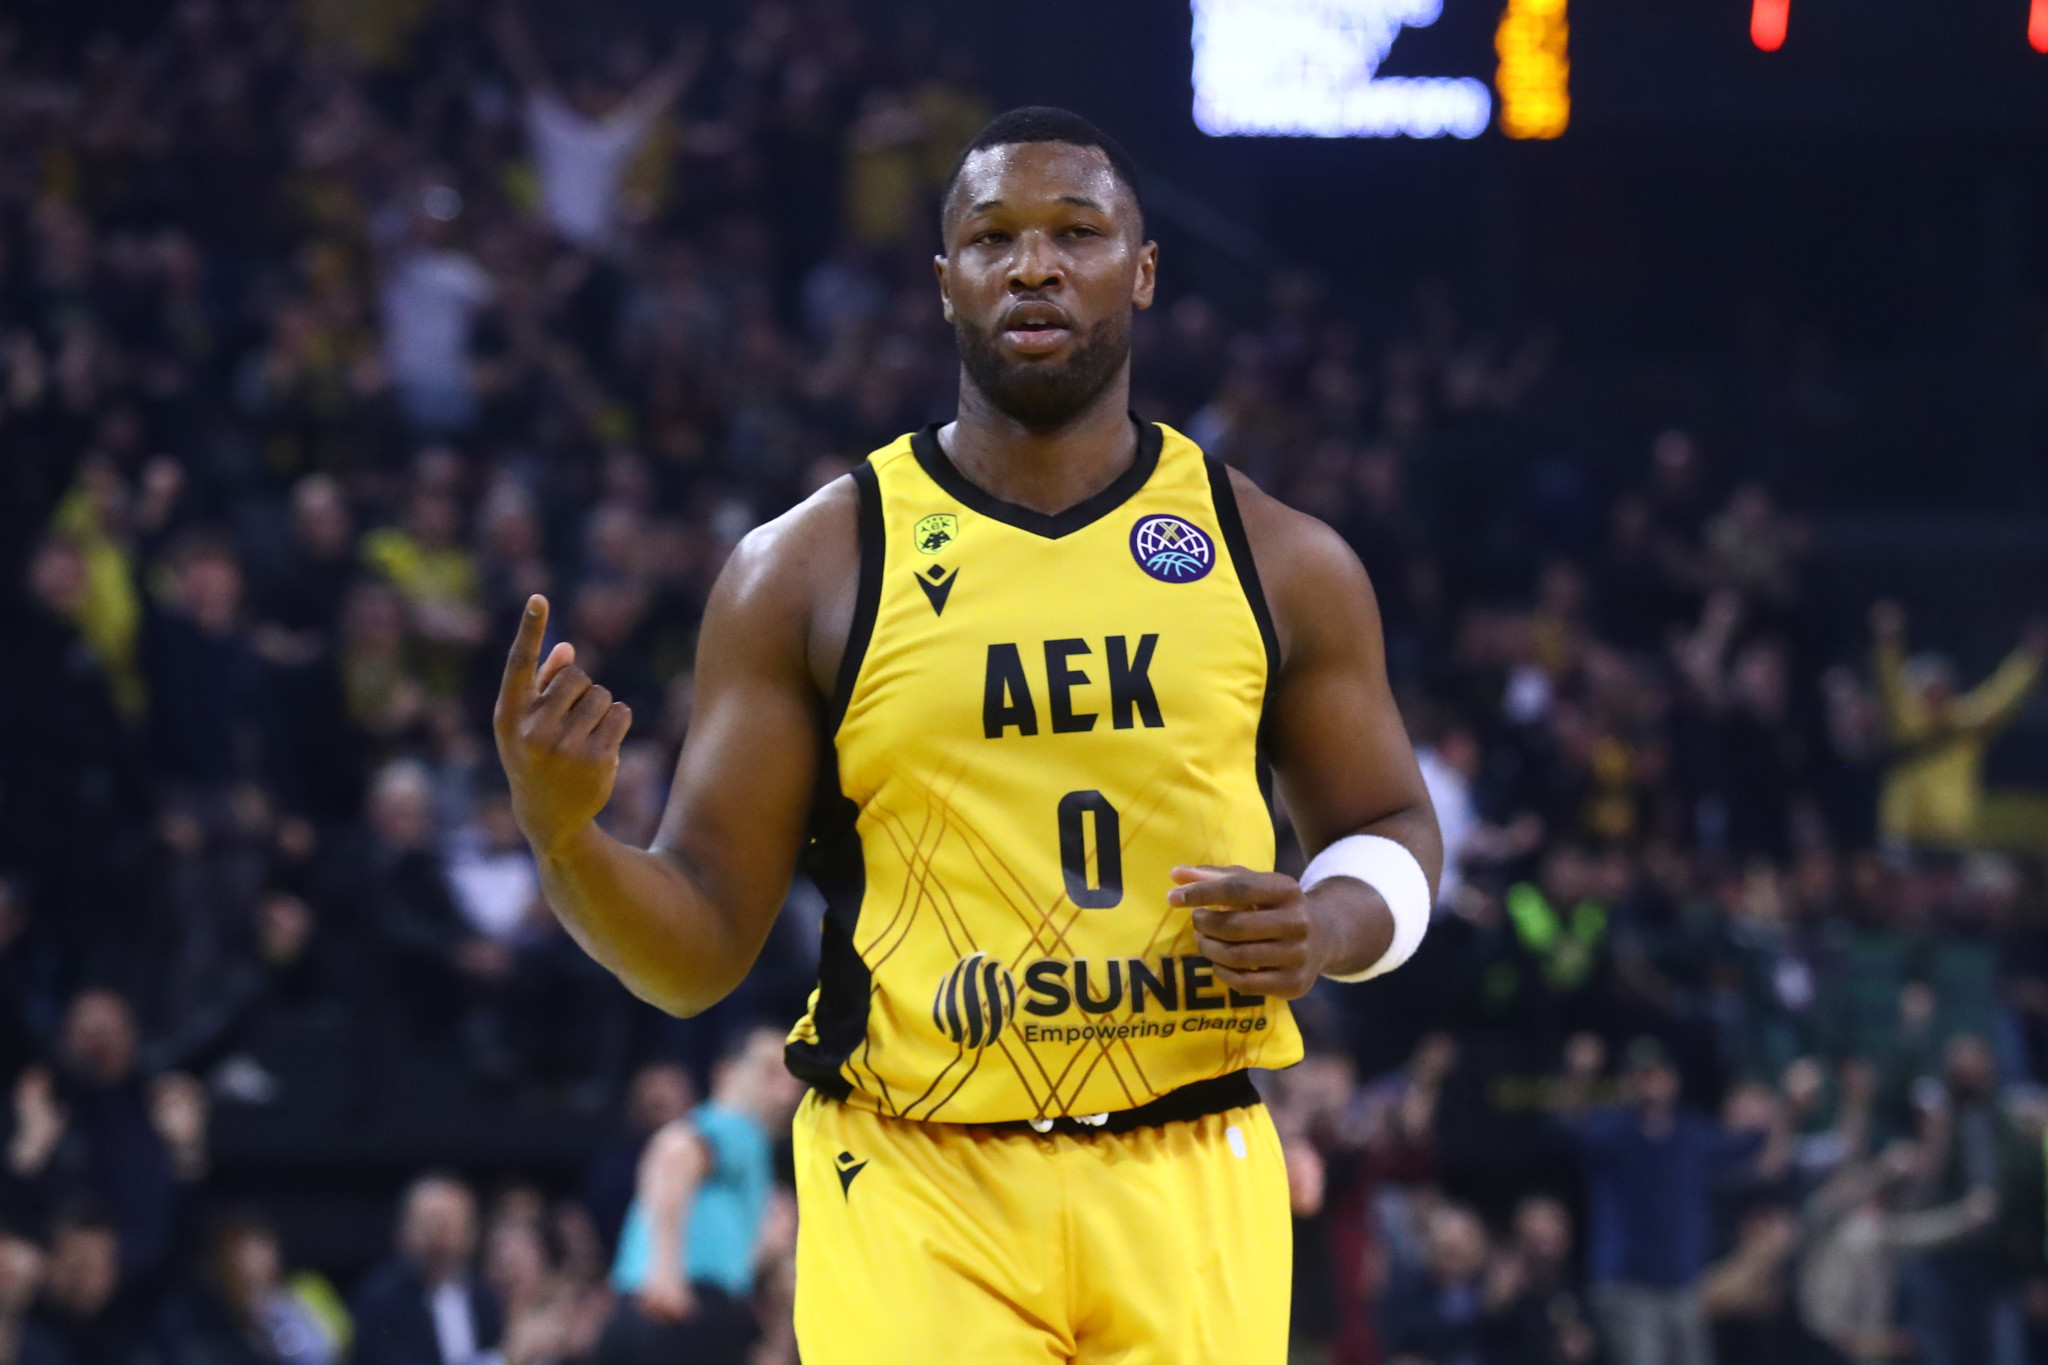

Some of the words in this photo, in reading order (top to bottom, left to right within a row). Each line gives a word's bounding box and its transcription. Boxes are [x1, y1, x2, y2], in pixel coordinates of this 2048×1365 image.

[983, 634, 1165, 738] AEK
[1058, 790, 1123, 909] 0
[1025, 1020, 1175, 1045] Empowering
[1182, 1017, 1266, 1032] Change
